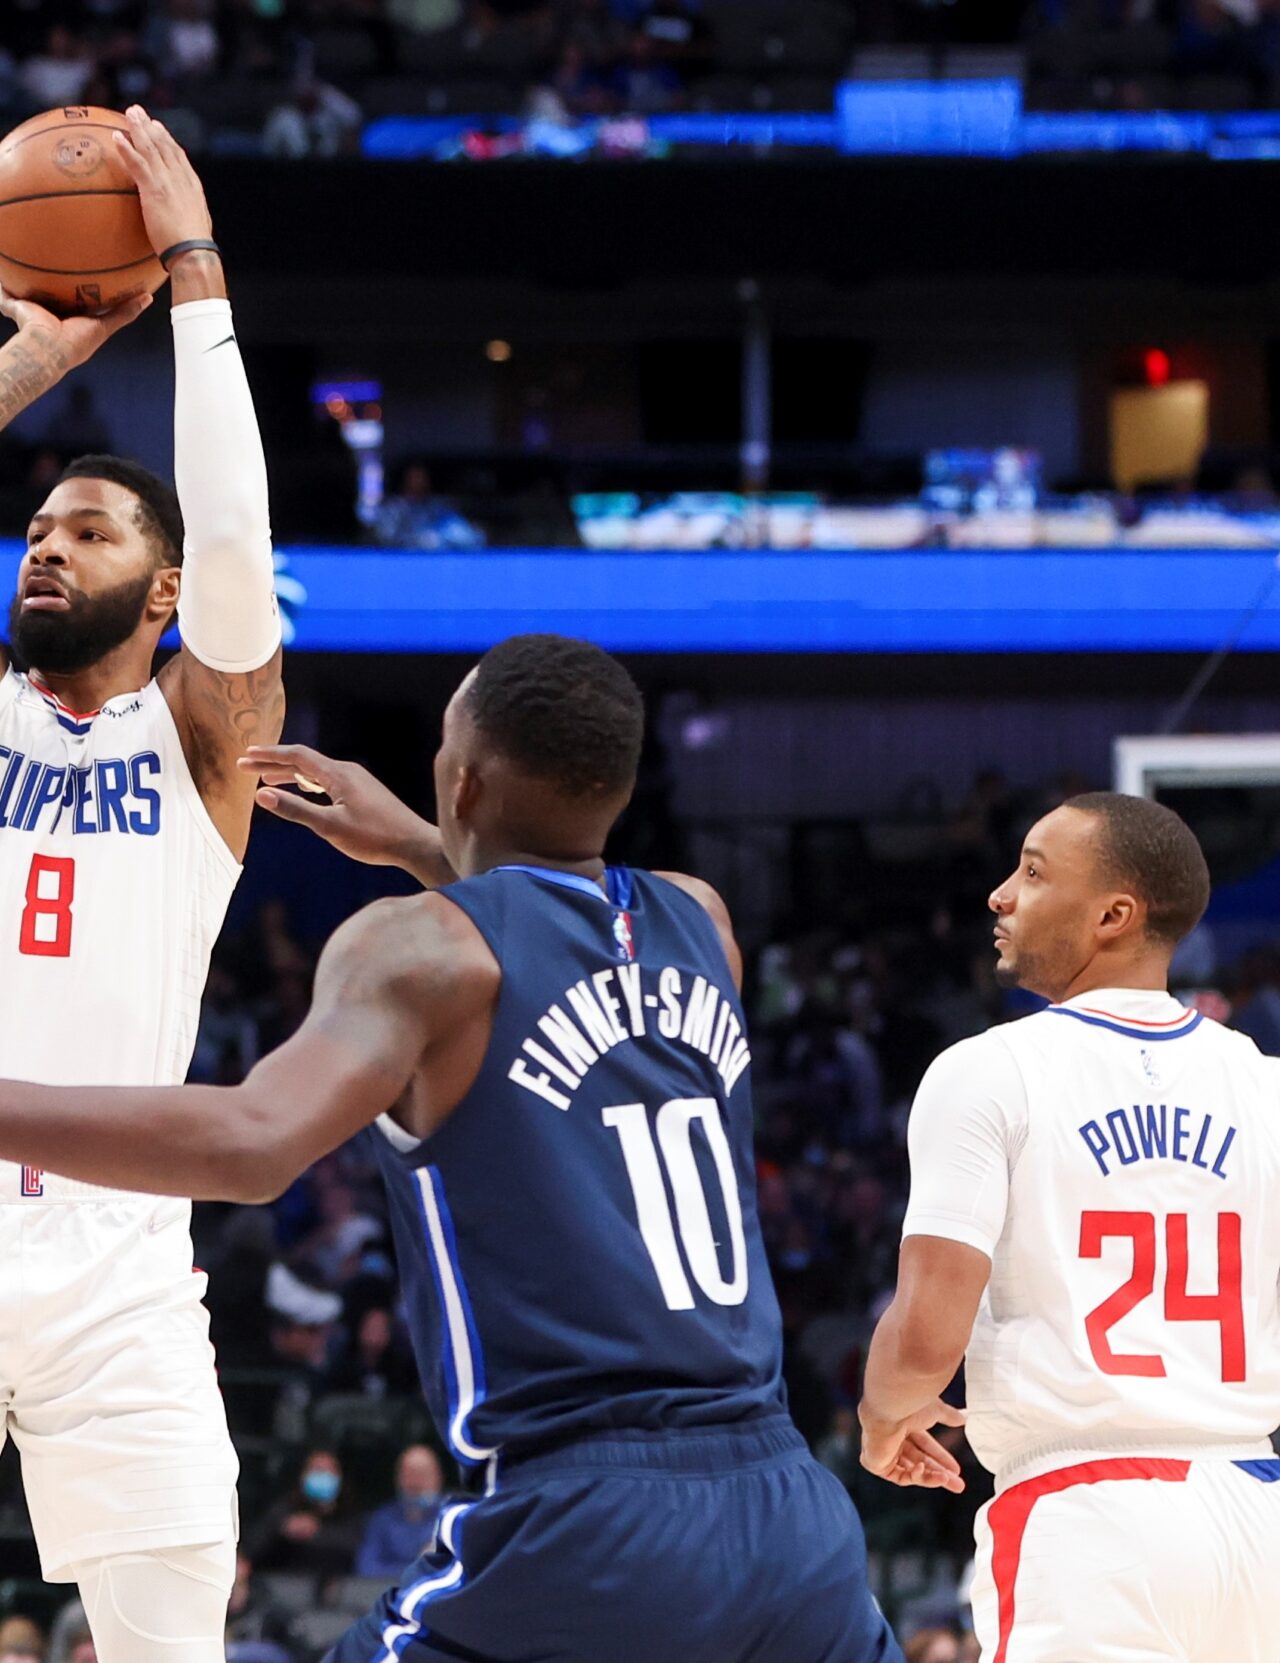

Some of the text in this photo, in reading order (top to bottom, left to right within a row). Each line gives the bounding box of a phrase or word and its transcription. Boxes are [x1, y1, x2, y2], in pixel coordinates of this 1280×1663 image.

[101, 699, 144, 719] oney
[19, 853, 75, 957] 8
[507, 963, 752, 1112] FINNEY-SMITH
[602, 1097, 749, 1310] 10
[1078, 1104, 1237, 1180] POWELL
[1078, 1210, 1246, 1382] 24
